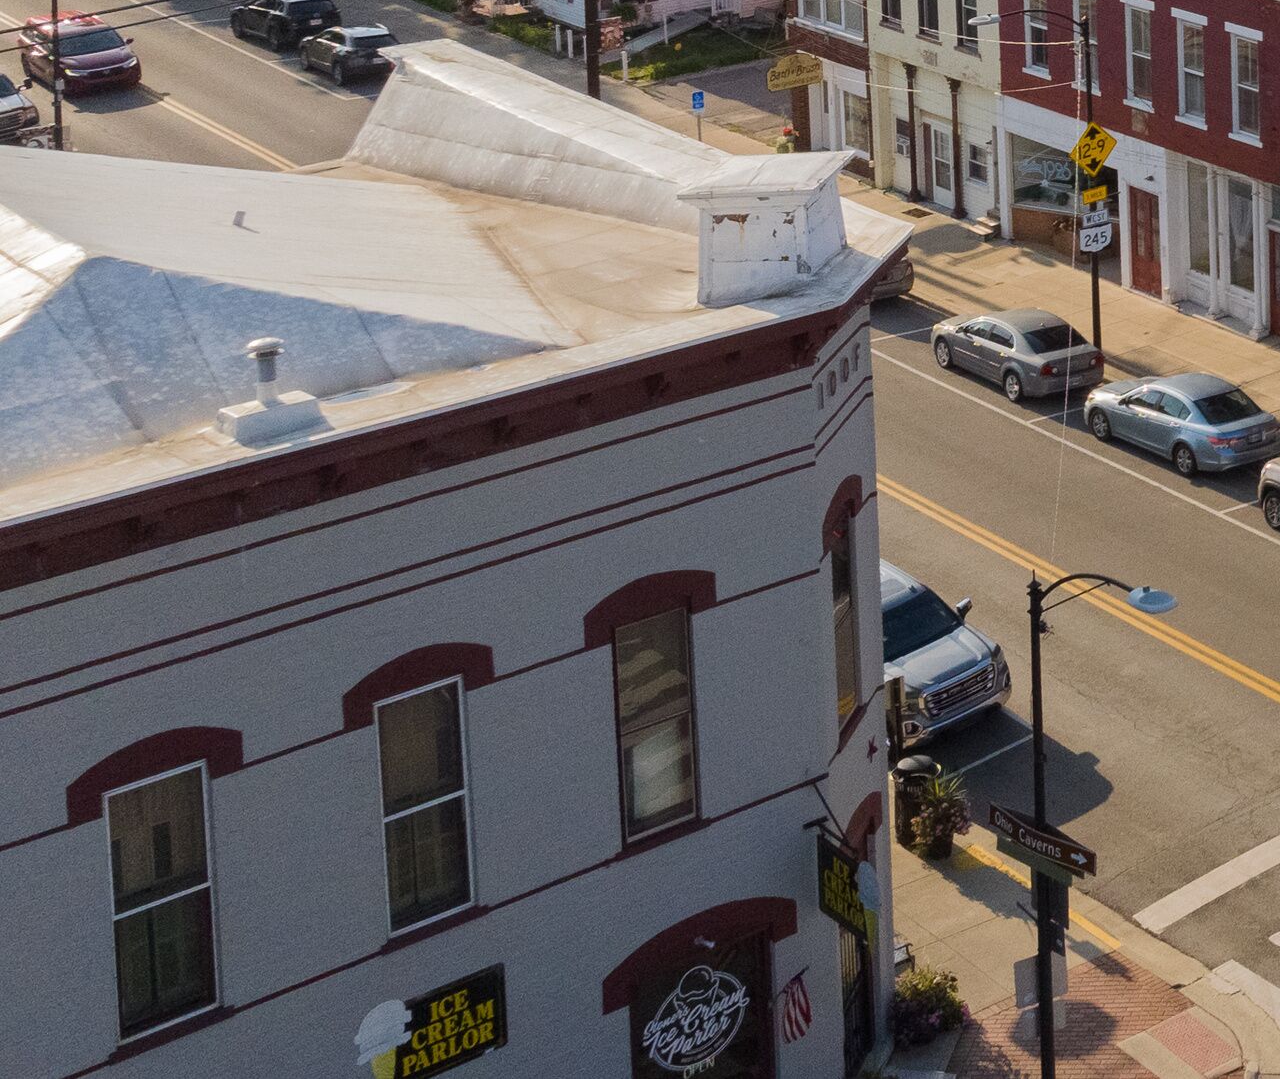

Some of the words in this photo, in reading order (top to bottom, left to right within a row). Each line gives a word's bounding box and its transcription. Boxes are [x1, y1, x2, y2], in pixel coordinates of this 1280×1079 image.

[1084, 231, 1107, 247] 245
[1086, 212, 1106, 224] WEST
[994, 811, 1013, 834] Ohio
[1019, 828, 1062, 858] Caverns
[832, 855, 850, 888] ICE
[412, 999, 494, 1050] CREAM
[430, 989, 469, 1023] ICE
[642, 1027, 679, 1059] Ice
[680, 986, 750, 1034] Cream
[402, 1022, 494, 1078] PARLOR
[661, 1014, 731, 1064] Parlor
